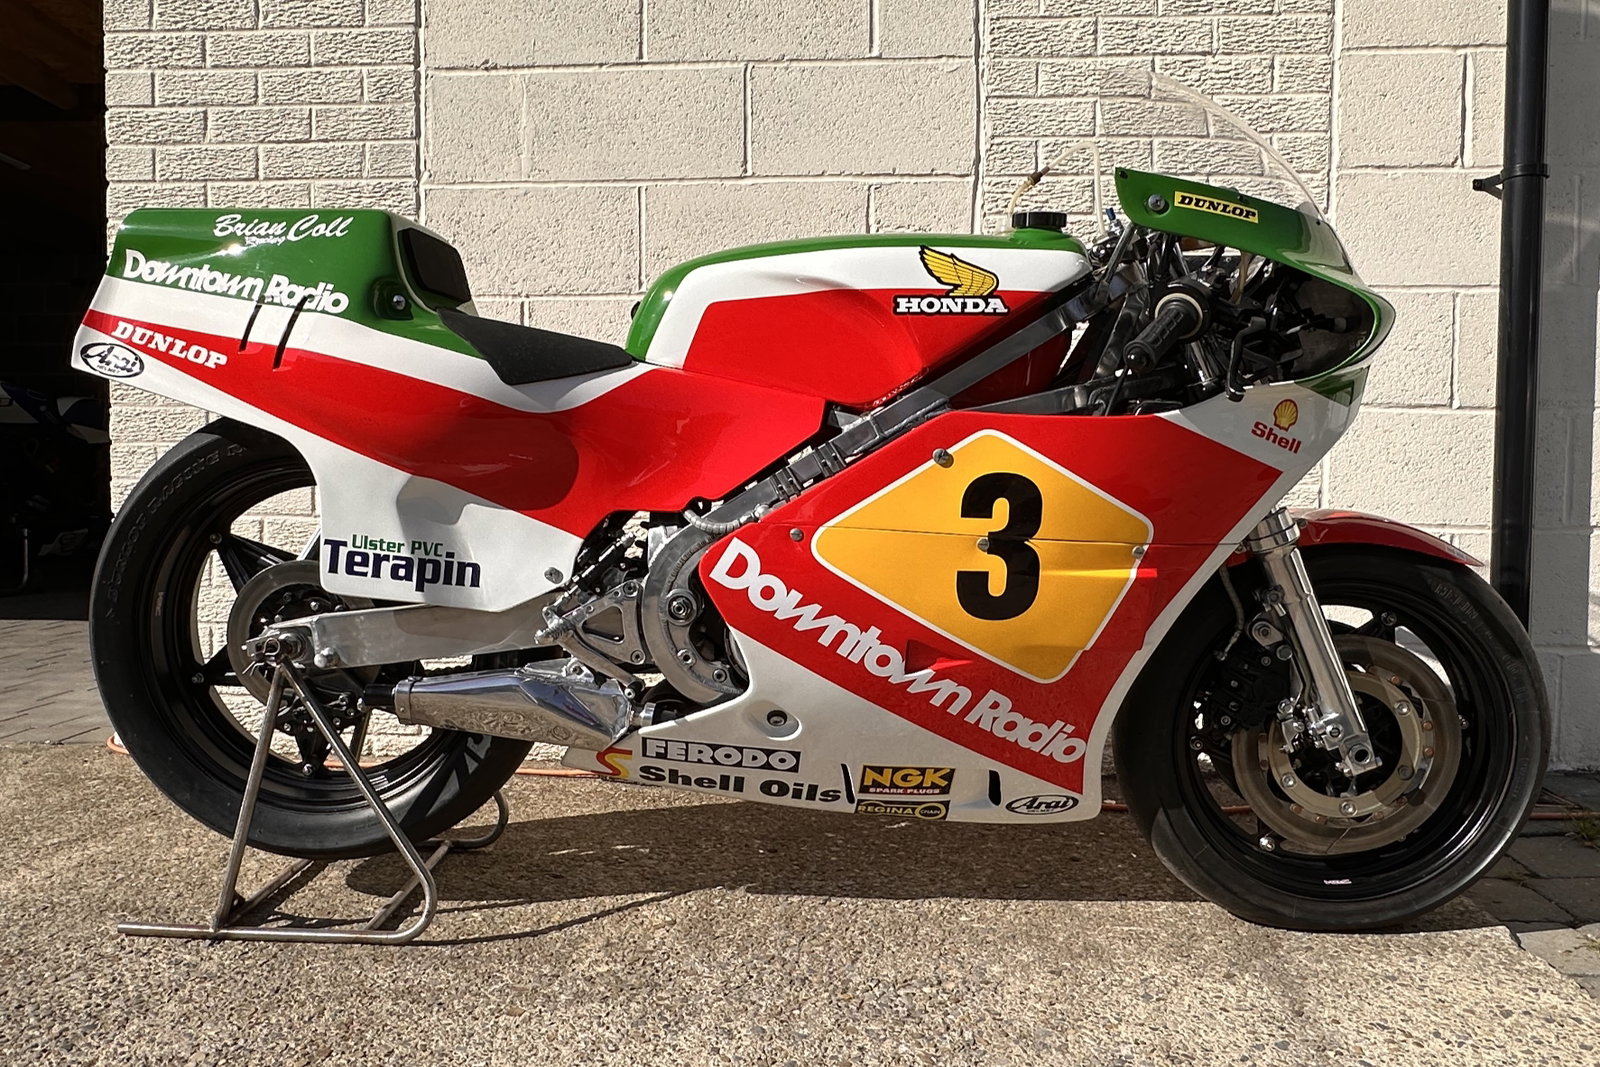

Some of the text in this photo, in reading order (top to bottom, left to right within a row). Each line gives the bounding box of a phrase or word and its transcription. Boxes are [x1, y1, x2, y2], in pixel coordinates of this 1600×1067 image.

[1177, 194, 1257, 220] DUNLOP
[213, 213, 354, 241] Brian Coll
[122, 249, 350, 314] Downtown Radio
[896, 297, 1008, 313] HONDA
[83, 345, 140, 373] Arai
[111, 320, 228, 370] DUNLOP
[1251, 420, 1302, 454] Shell
[351, 533, 444, 558] Ulster PVC
[955, 471, 1044, 621] 3
[323, 538, 481, 593] Terapin
[708, 536, 1087, 764] Downtown Radio
[645, 738, 797, 770] FERODO
[639, 765, 842, 803] Shell Oils
[863, 767, 950, 788] NGK
[857, 805, 913, 815] REGINA
[1010, 796, 1072, 810] Arai
